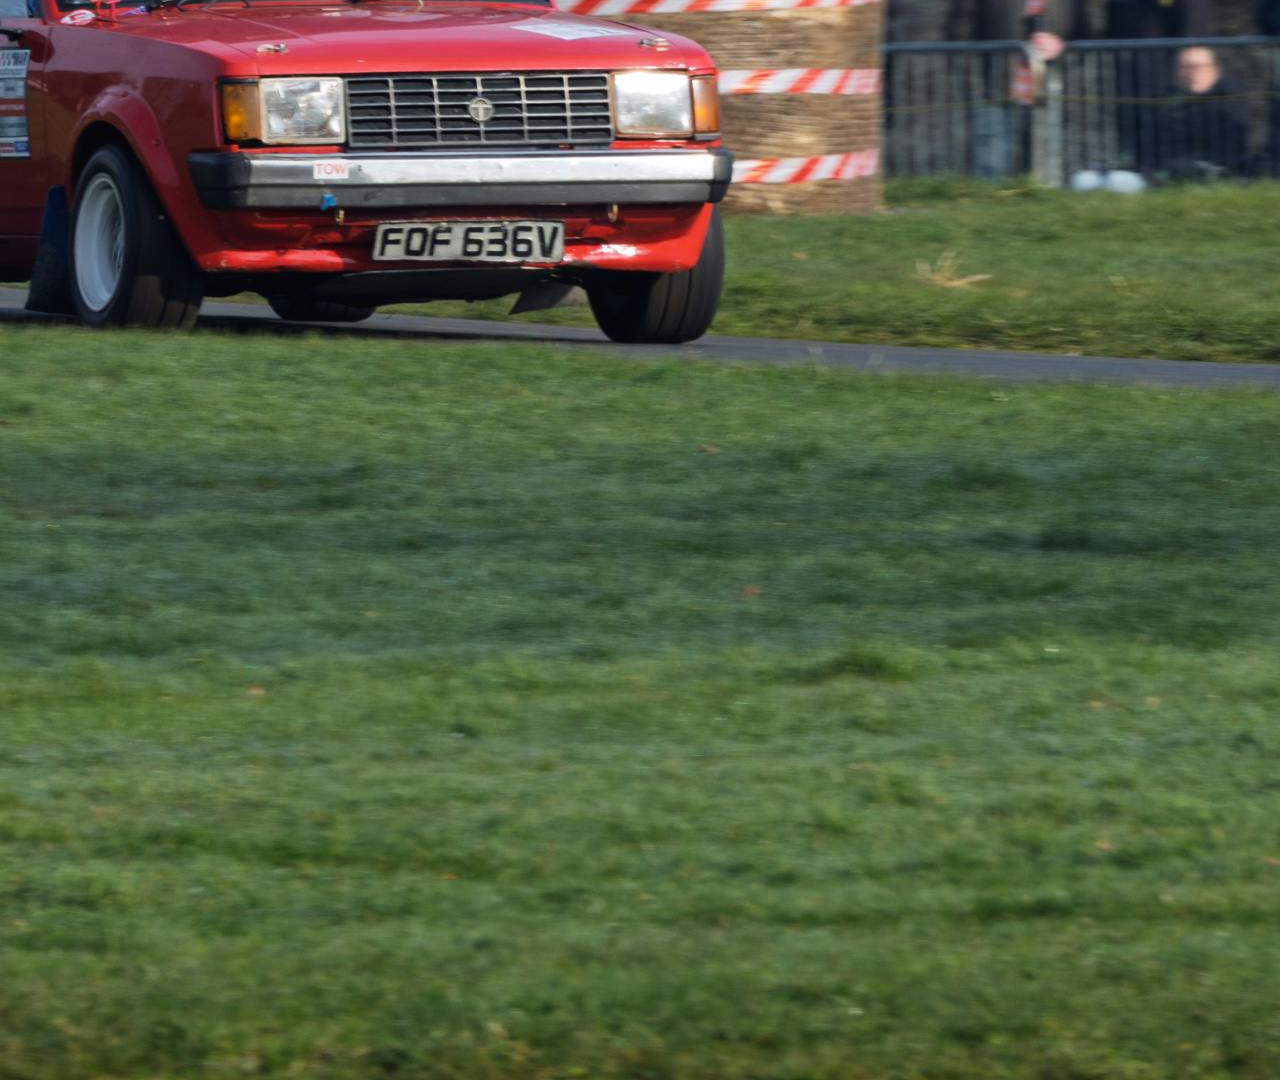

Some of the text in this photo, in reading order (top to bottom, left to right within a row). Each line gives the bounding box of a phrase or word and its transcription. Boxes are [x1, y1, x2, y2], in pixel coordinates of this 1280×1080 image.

[315, 162, 346, 175] TOW
[379, 225, 559, 258] FOF 636V
